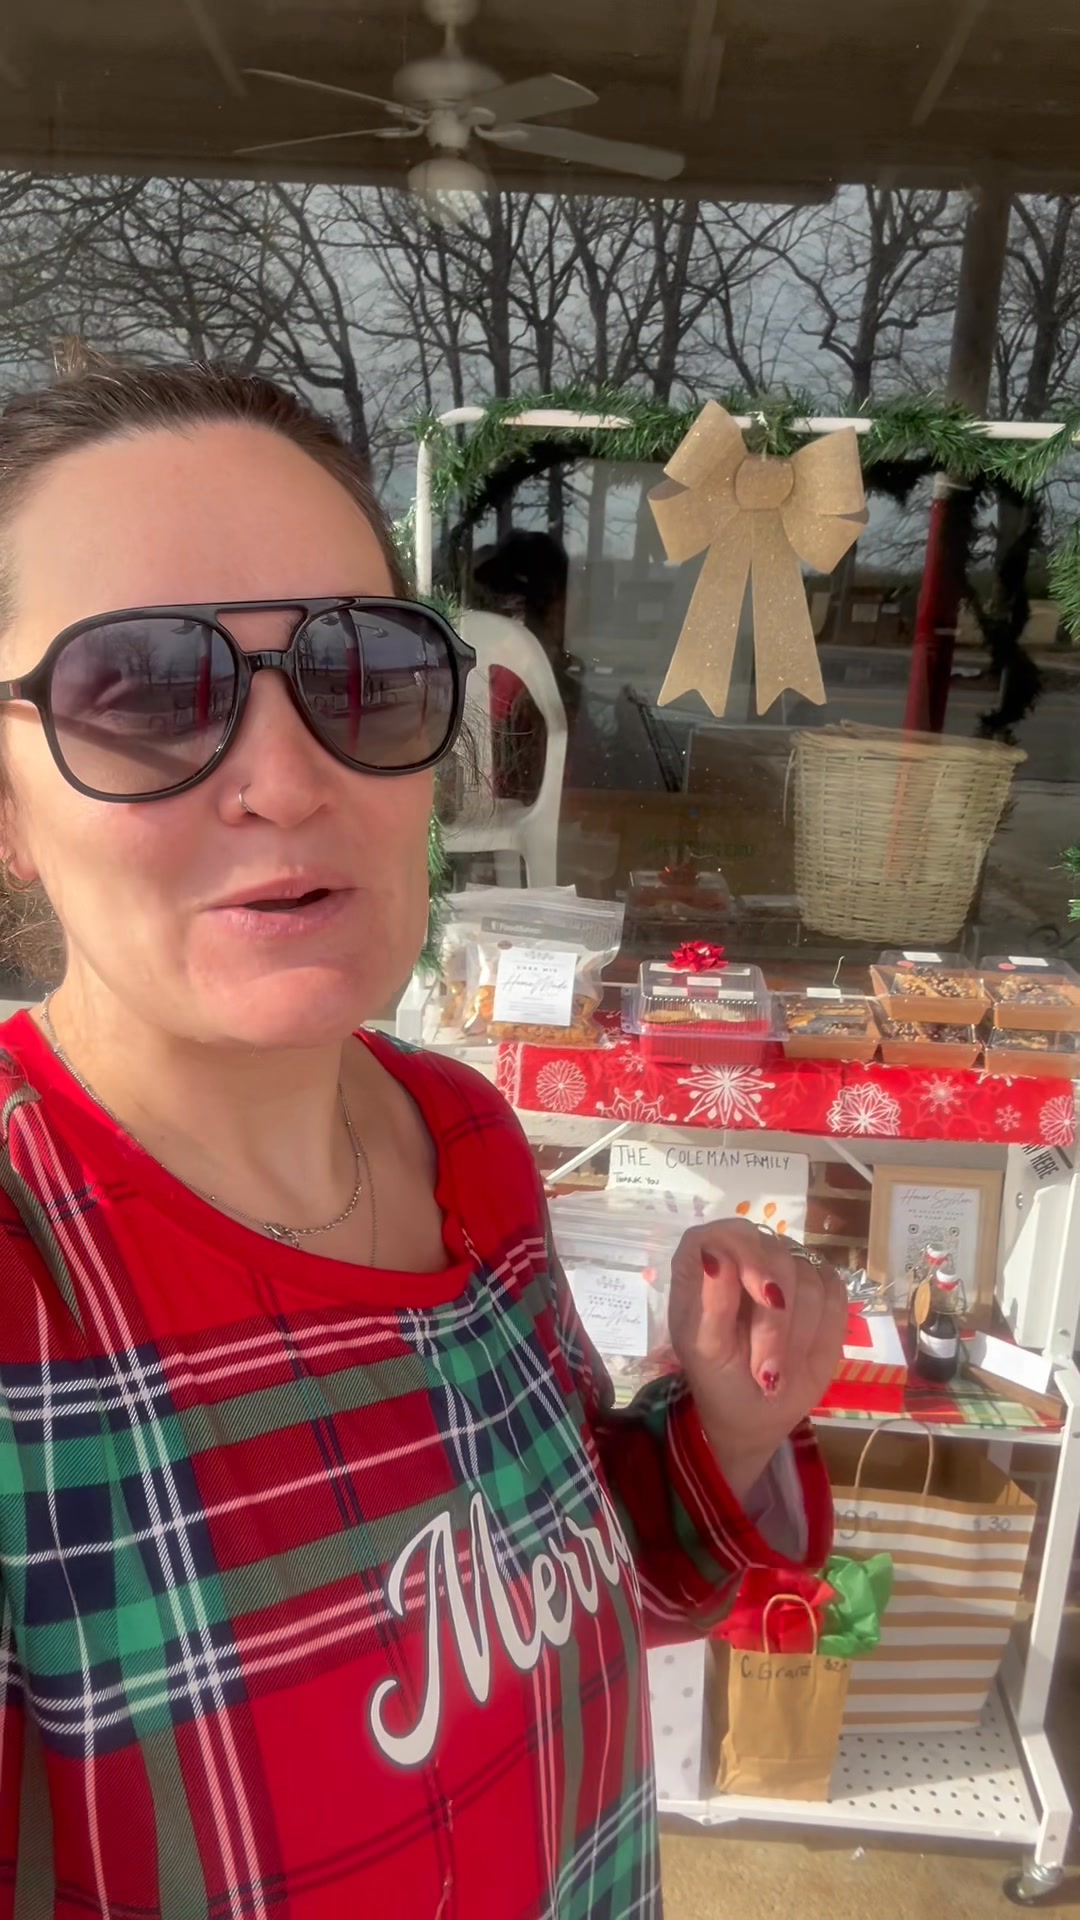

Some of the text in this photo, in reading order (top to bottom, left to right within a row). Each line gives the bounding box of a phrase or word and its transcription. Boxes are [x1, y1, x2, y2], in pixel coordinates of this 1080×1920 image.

[613, 1145, 790, 1171] THE COLEMAN FAMILY
[1030, 1150, 1060, 1180] HERE
